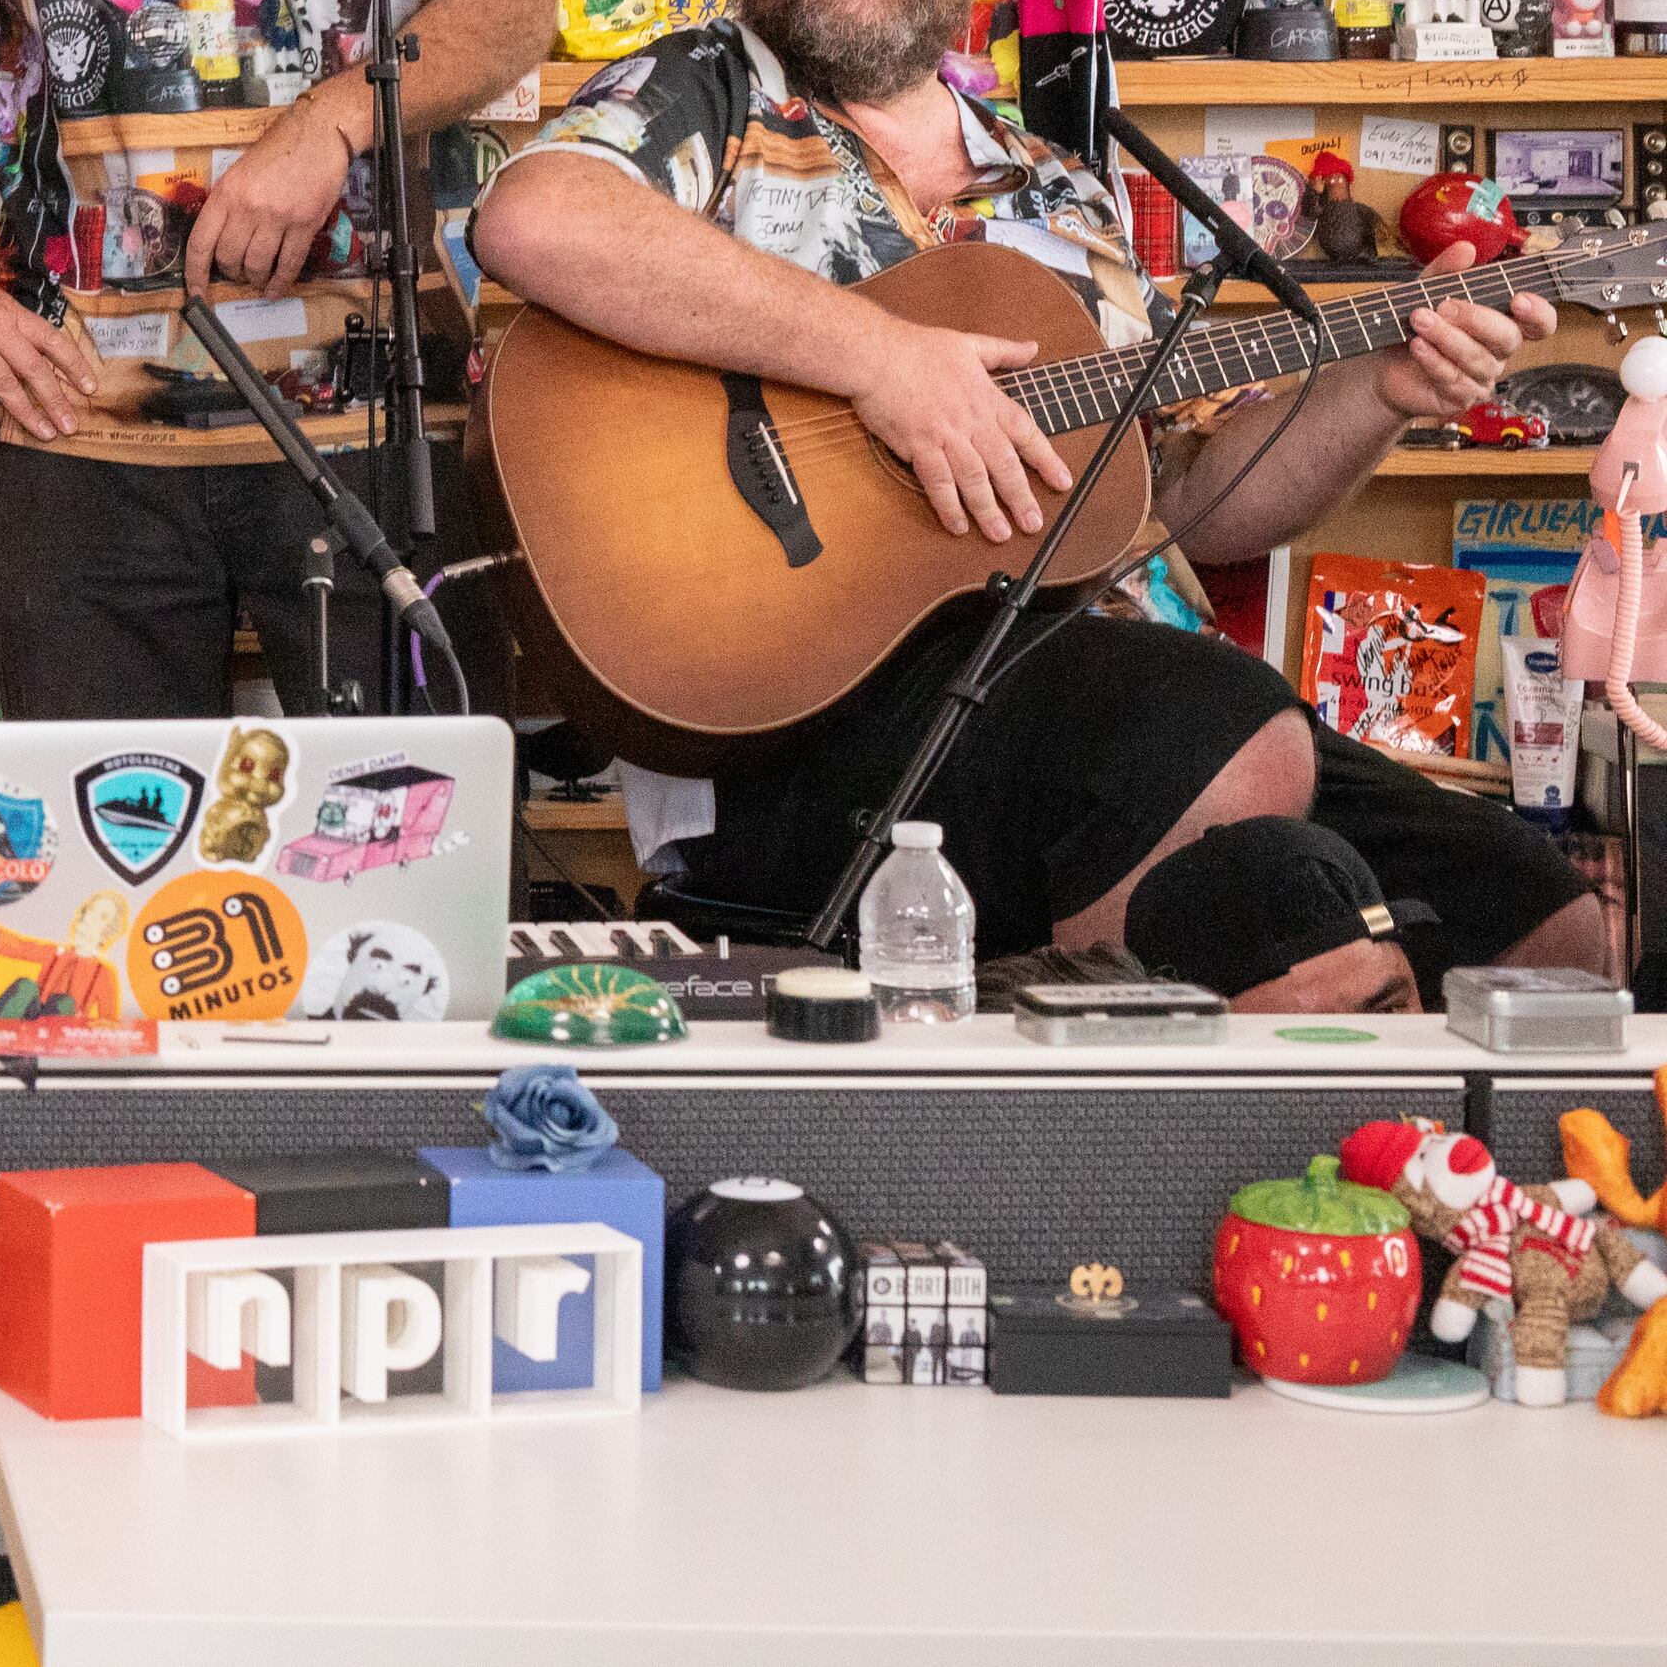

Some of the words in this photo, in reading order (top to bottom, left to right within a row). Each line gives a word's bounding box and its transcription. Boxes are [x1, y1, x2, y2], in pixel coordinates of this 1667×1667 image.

[1137, 9, 1215, 50] DEEDEE
[1331, 671, 1395, 697] swing
[1399, 674, 1450, 698] bass
[144, 892, 285, 999] 31
[168, 966, 295, 1021] MINUTOS
[187, 1259, 592, 1404] npr
